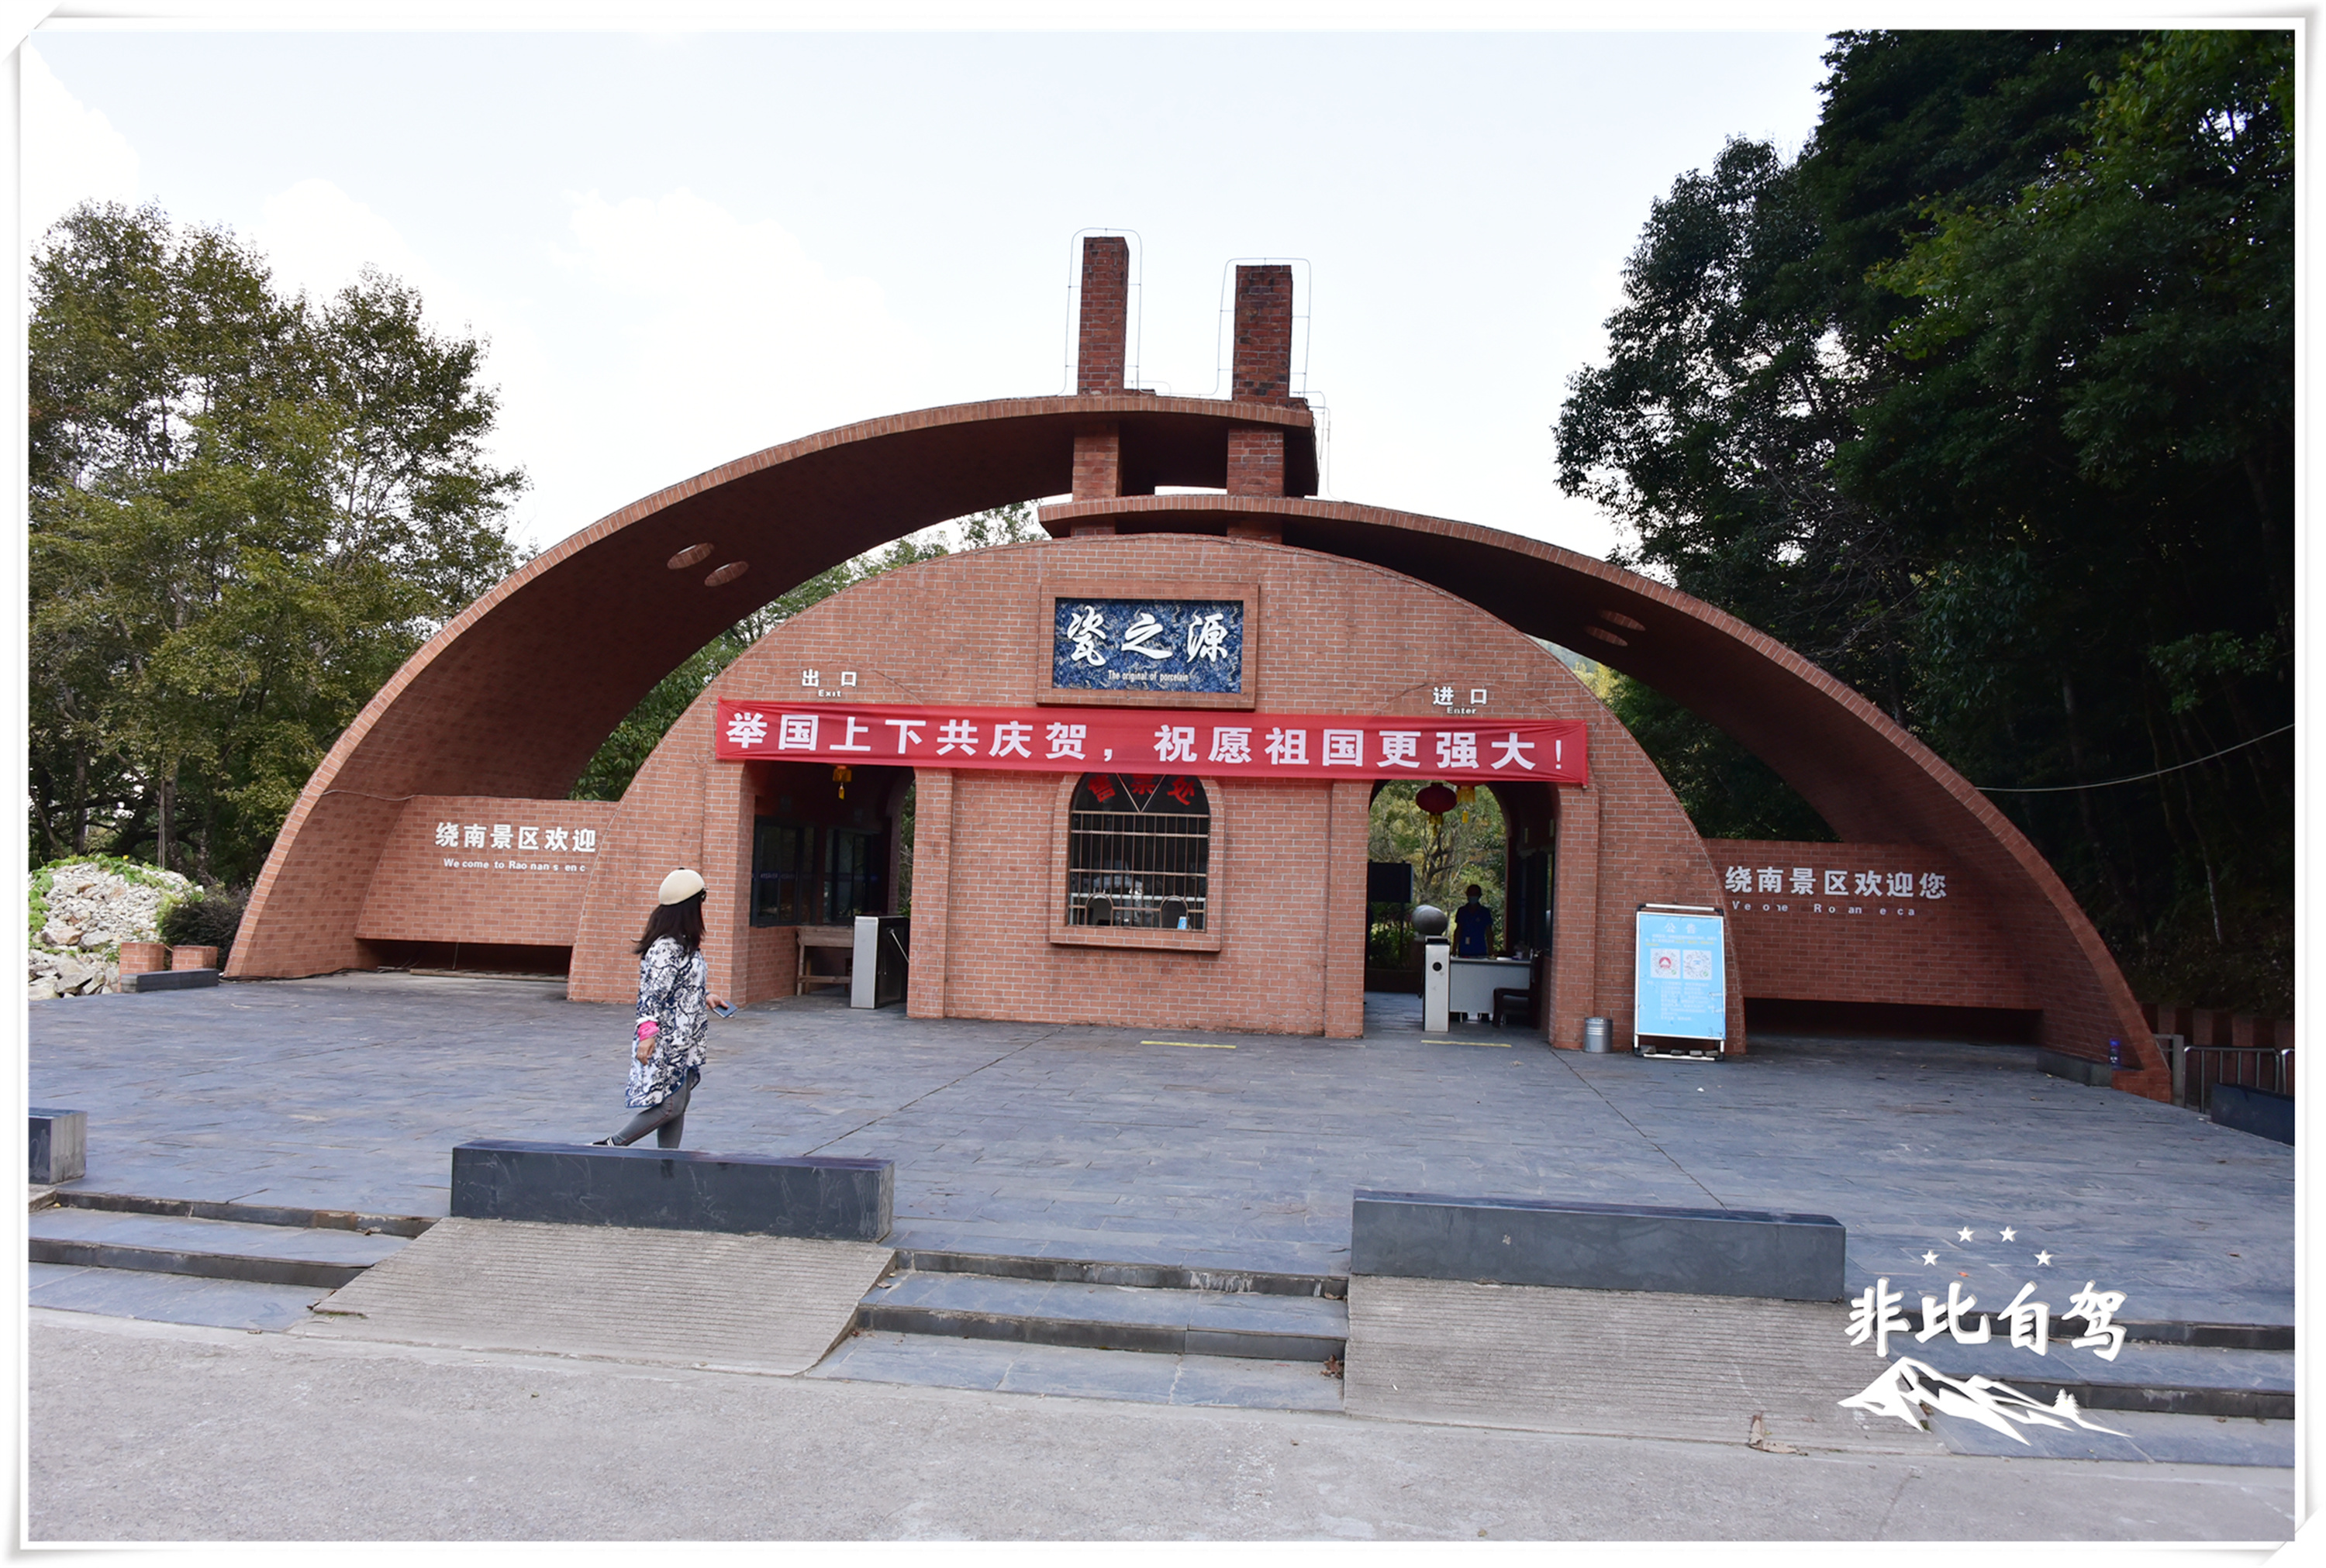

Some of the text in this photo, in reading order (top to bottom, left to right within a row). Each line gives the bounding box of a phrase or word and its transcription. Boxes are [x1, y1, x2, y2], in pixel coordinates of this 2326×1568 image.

[1066, 605, 1229, 667] 瓷之源
[802, 668, 858, 688] 出口
[1108, 670, 1189, 683] The original of porcelain
[818, 689, 841, 698] Exit
[1432, 686, 1488, 705] 进口
[1447, 706, 1477, 715] Enter
[435, 822, 597, 853] 绕南景区欢迎
[494, 860, 505, 870] to
[1724, 866, 1947, 900] 绕南景区欢迎您
